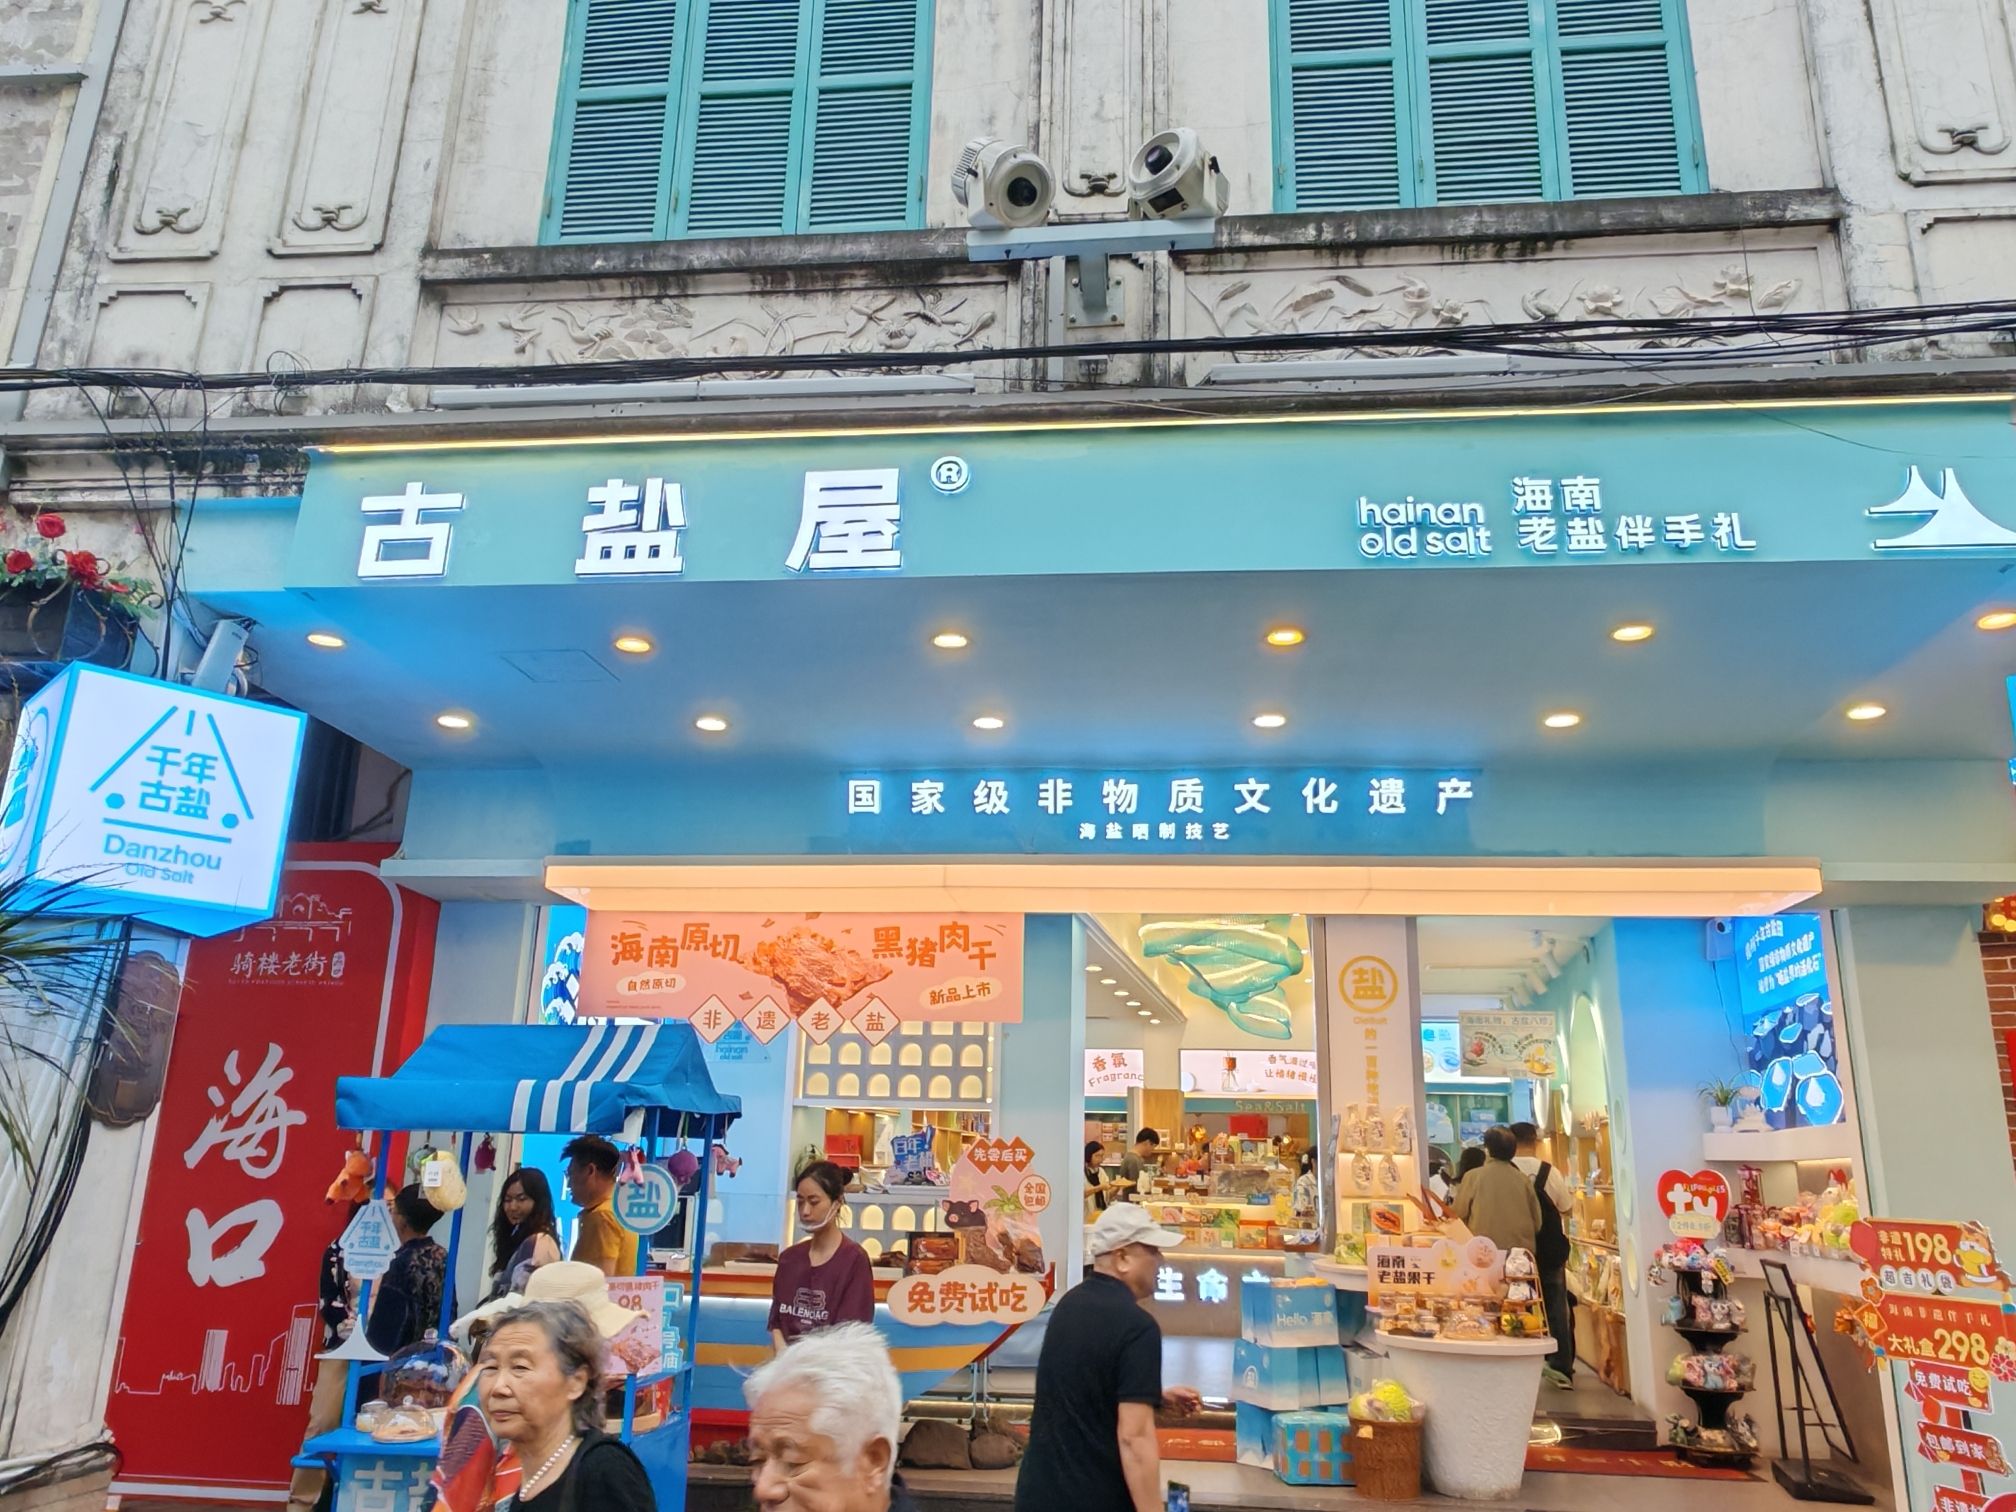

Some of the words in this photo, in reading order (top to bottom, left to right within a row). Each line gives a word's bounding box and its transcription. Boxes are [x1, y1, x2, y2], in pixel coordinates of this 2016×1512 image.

[1512, 475, 1602, 513] 海南
[358, 468, 903, 578] 古盐屋
[1358, 496, 1485, 526] hainan
[1359, 527, 1418, 558] old
[1424, 526, 1493, 558] salt
[1517, 512, 1757, 553] 老盐伴手礼
[145, 745, 219, 784] 千年
[138, 780, 212, 820] 古盐
[847, 777, 1474, 816] 国家级非物质文化遗产
[1079, 822, 1232, 841] 海盐晒制技艺
[103, 833, 222, 871] Danzhou
[161, 867, 194, 885] Salt
[610, 922, 745, 969] 海南原切
[871, 921, 996, 970] 黑猪肉干
[230, 951, 327, 978] 骑楼老街
[627, 978, 677, 992] 自然原切
[929, 981, 991, 1006] 新品上市
[1352, 967, 1387, 1000] 盐
[183, 1042, 307, 1287] 海口
[974, 1148, 1028, 1163] 先尝后买
[1024, 1182, 1046, 1194] 全国
[1902, 1231, 1952, 1265] 198
[1377, 1271, 1436, 1285] 老盐果干
[907, 1281, 1028, 1314] 免费试吃
[1276, 1313, 1308, 1328] Hello
[1888, 1333, 1936, 1358] 大礼盒
[1934, 1328, 1990, 1366] 298
[1914, 1369, 1973, 1397] 免费试吃
